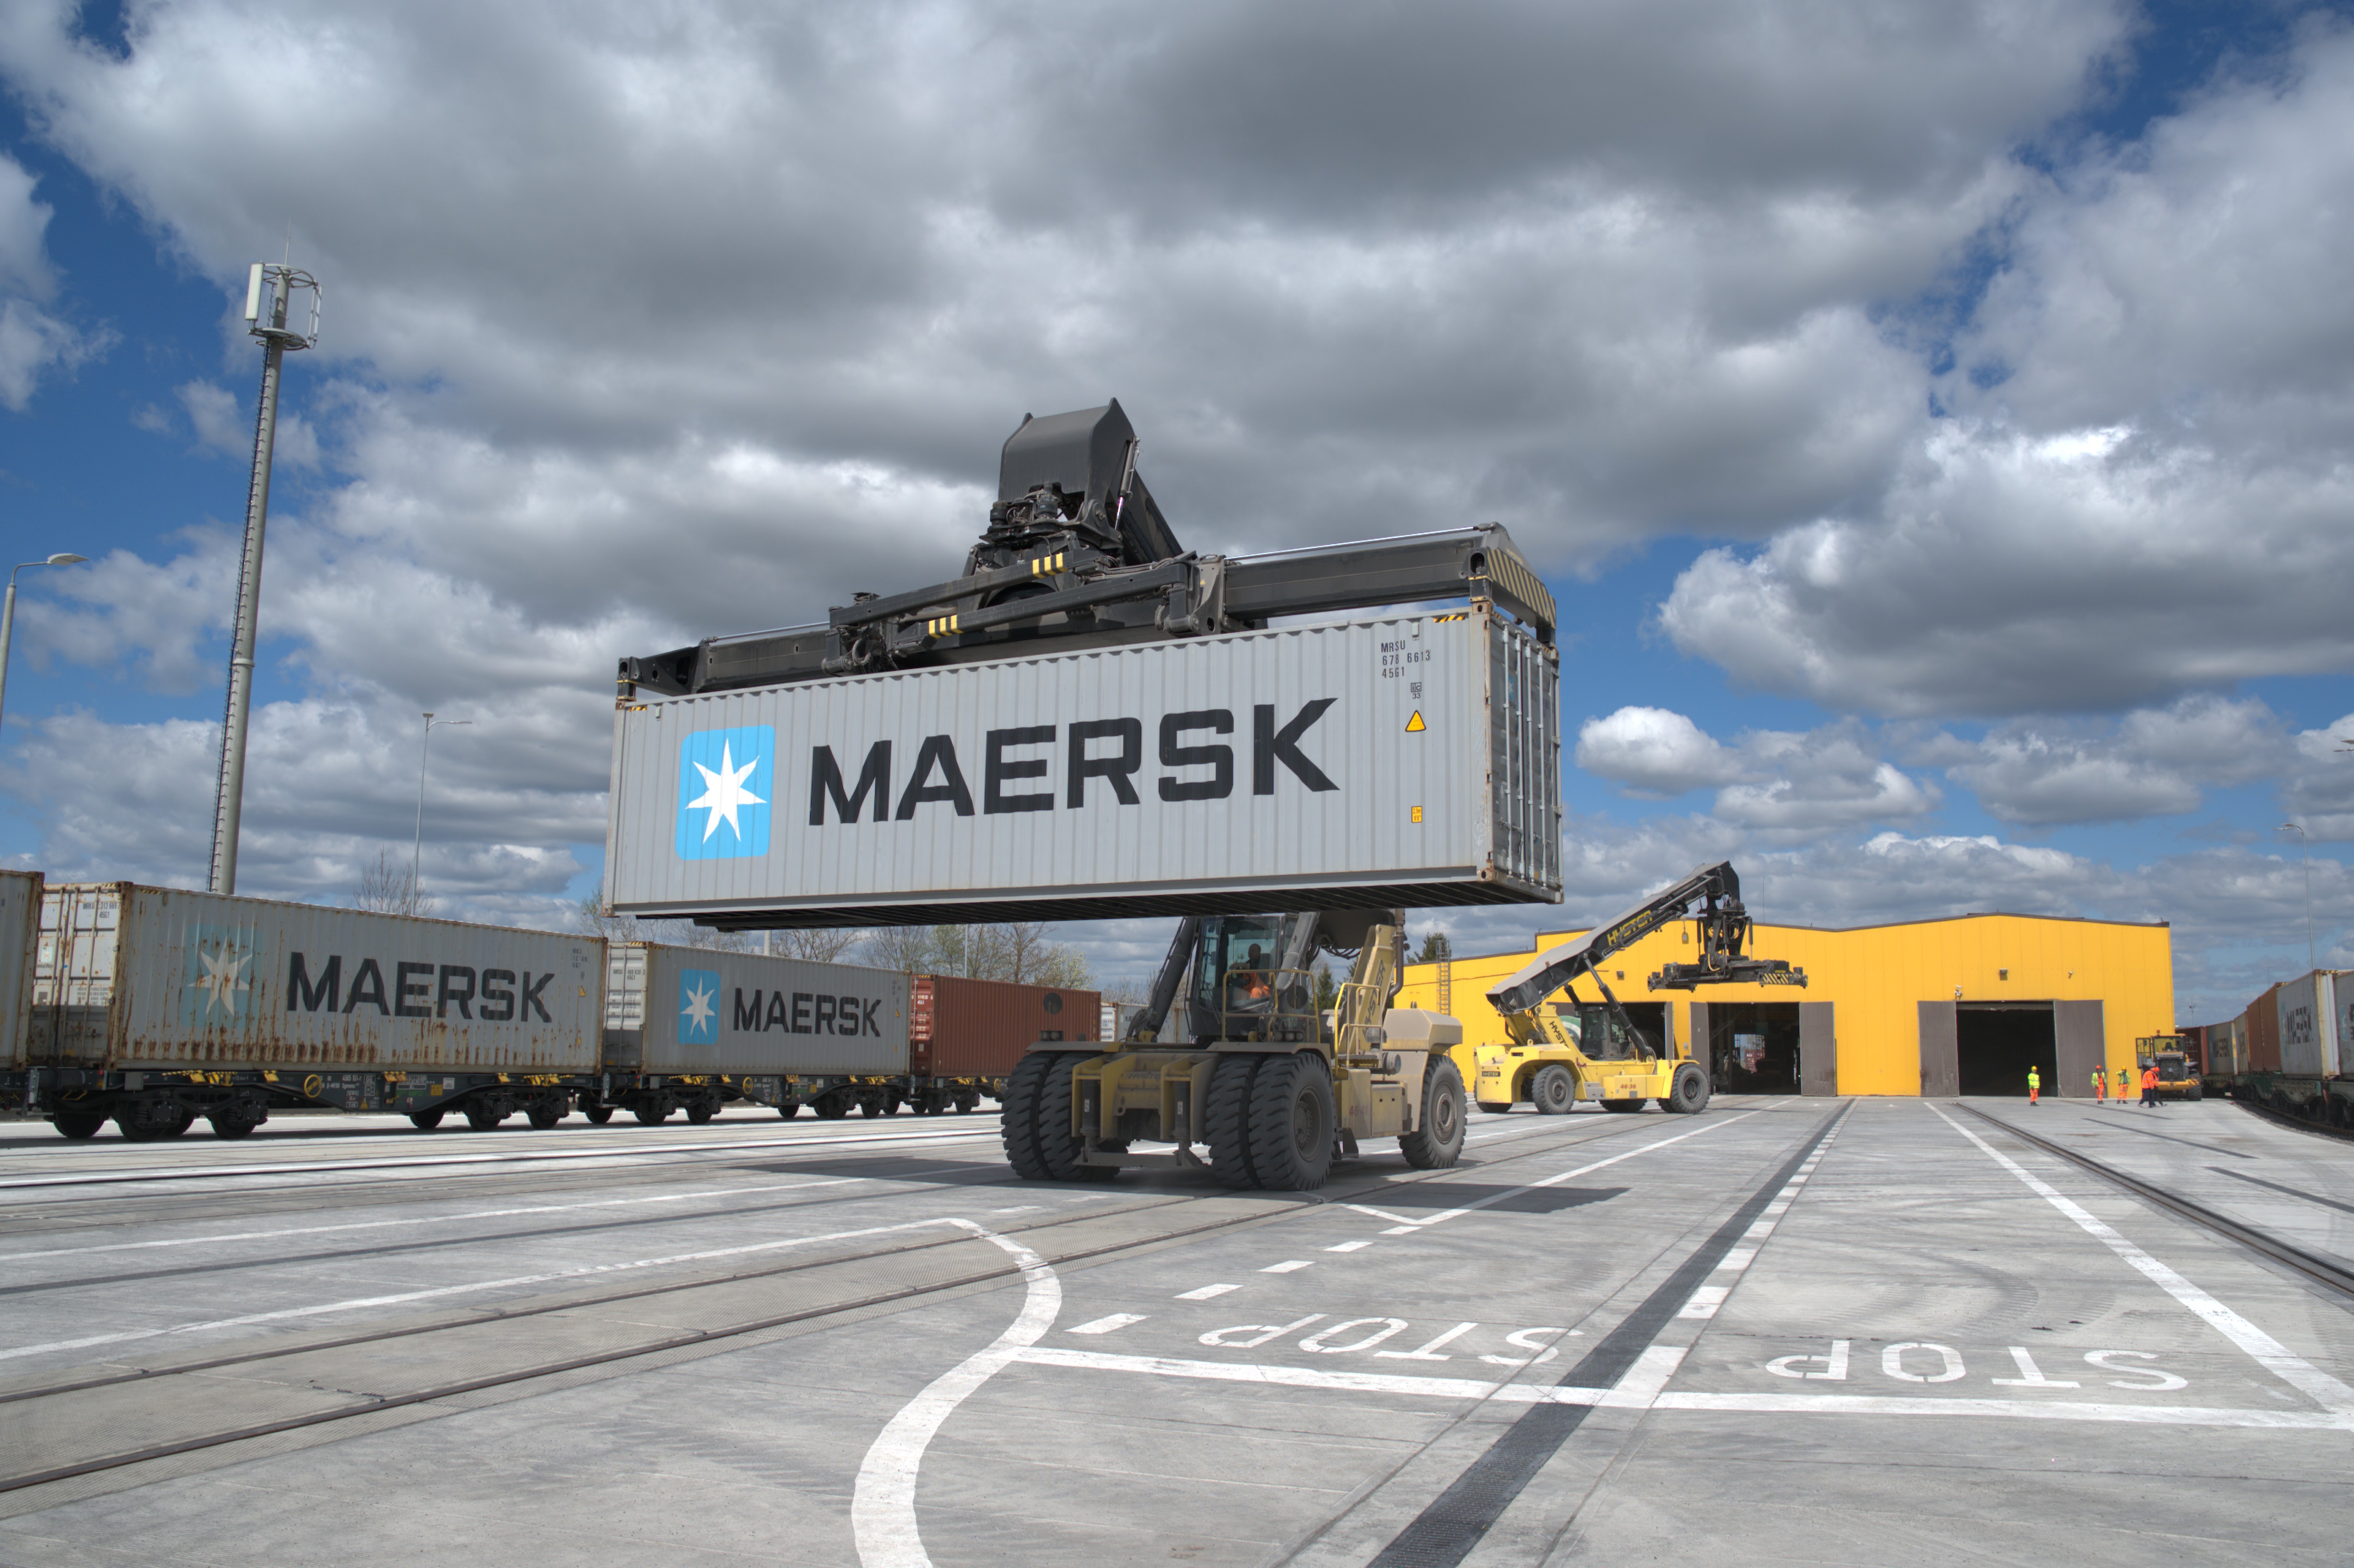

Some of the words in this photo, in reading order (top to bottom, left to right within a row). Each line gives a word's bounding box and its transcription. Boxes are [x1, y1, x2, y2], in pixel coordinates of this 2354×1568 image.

[1381, 640, 1405, 653] MRSU
[1382, 654, 1399, 665] 678
[1382, 666, 1404, 678] 45G1
[809, 697, 1341, 826] MAERSK
[82, 902, 95, 910] MRKU
[287, 952, 555, 1023] MAERSK
[733, 987, 882, 1038] MAERSK
[1549, 1020, 1569, 1049] HYST
[1198, 1313, 1585, 1366] STOP
[1765, 1340, 2189, 1391] STOP
